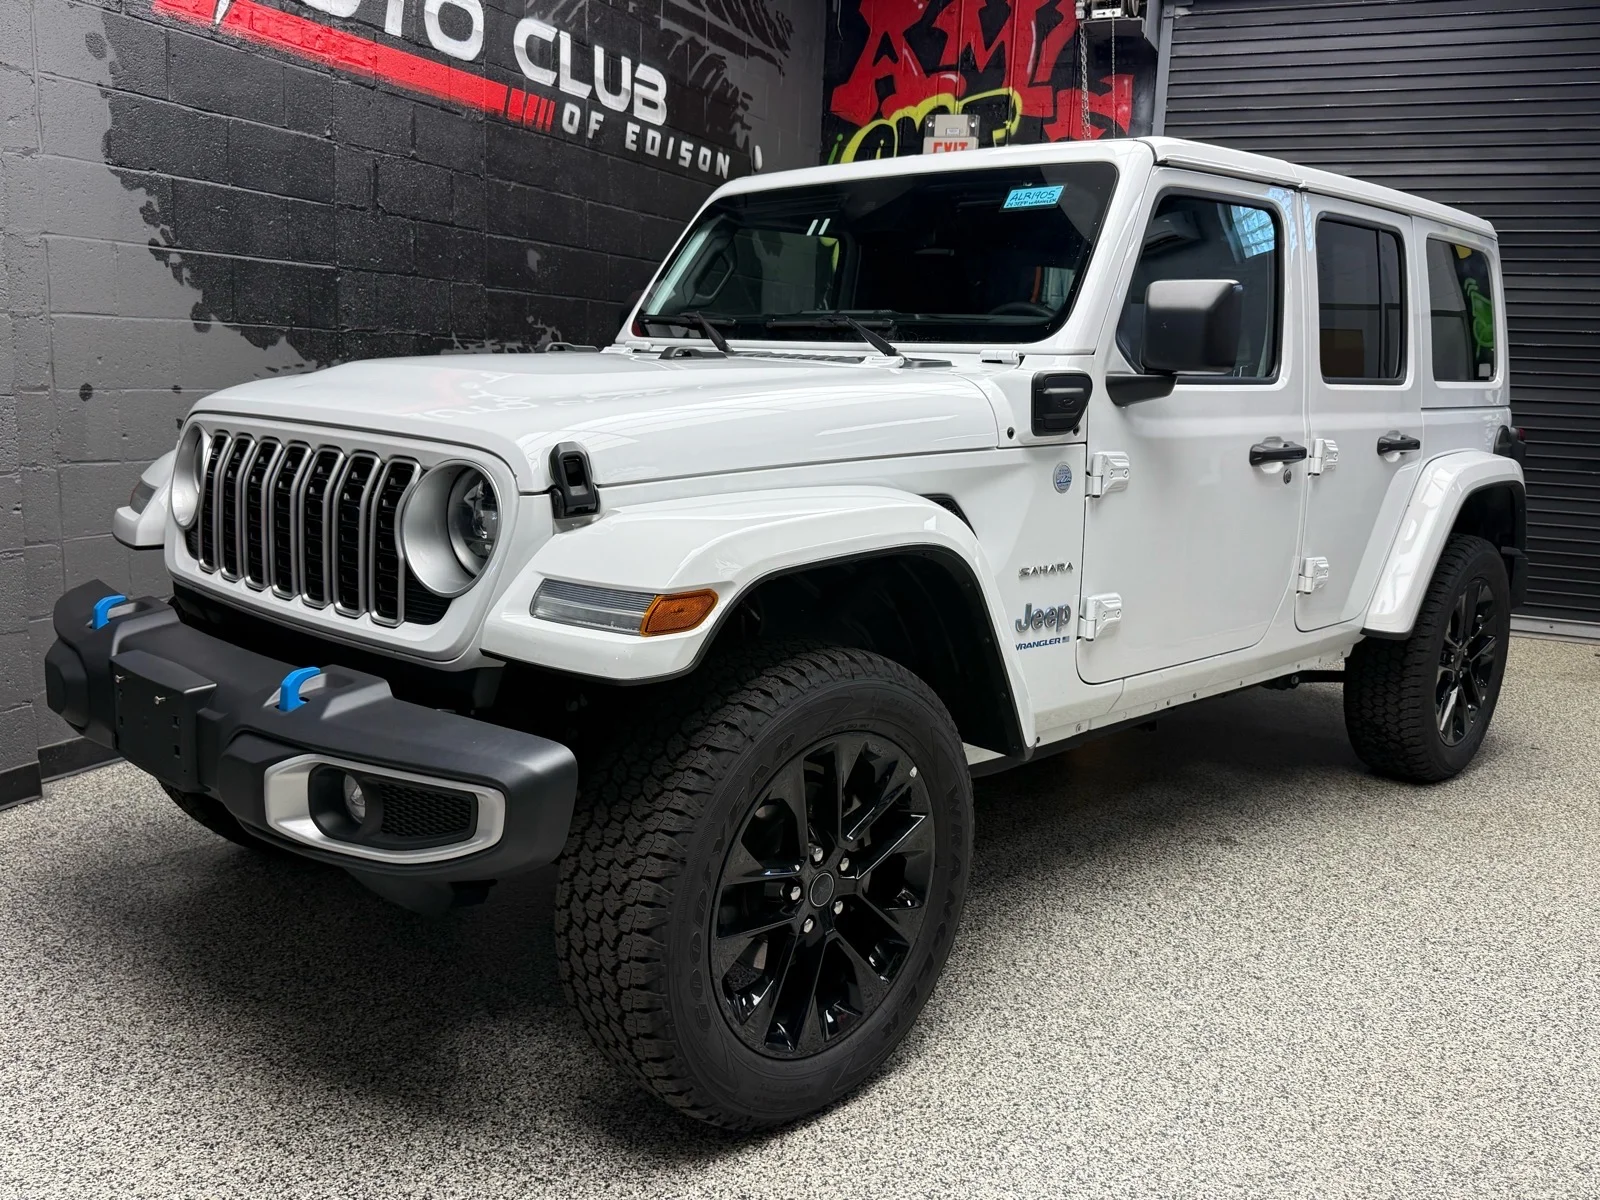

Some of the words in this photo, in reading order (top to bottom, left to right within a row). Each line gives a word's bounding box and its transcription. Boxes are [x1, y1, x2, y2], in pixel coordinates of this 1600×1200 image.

[513, 18, 667, 126] CLUB
[561, 102, 604, 139] OF
[625, 121, 730, 179] EDISON
[1019, 562, 1074, 578] SAHARA
[1015, 603, 1071, 632] Jeep
